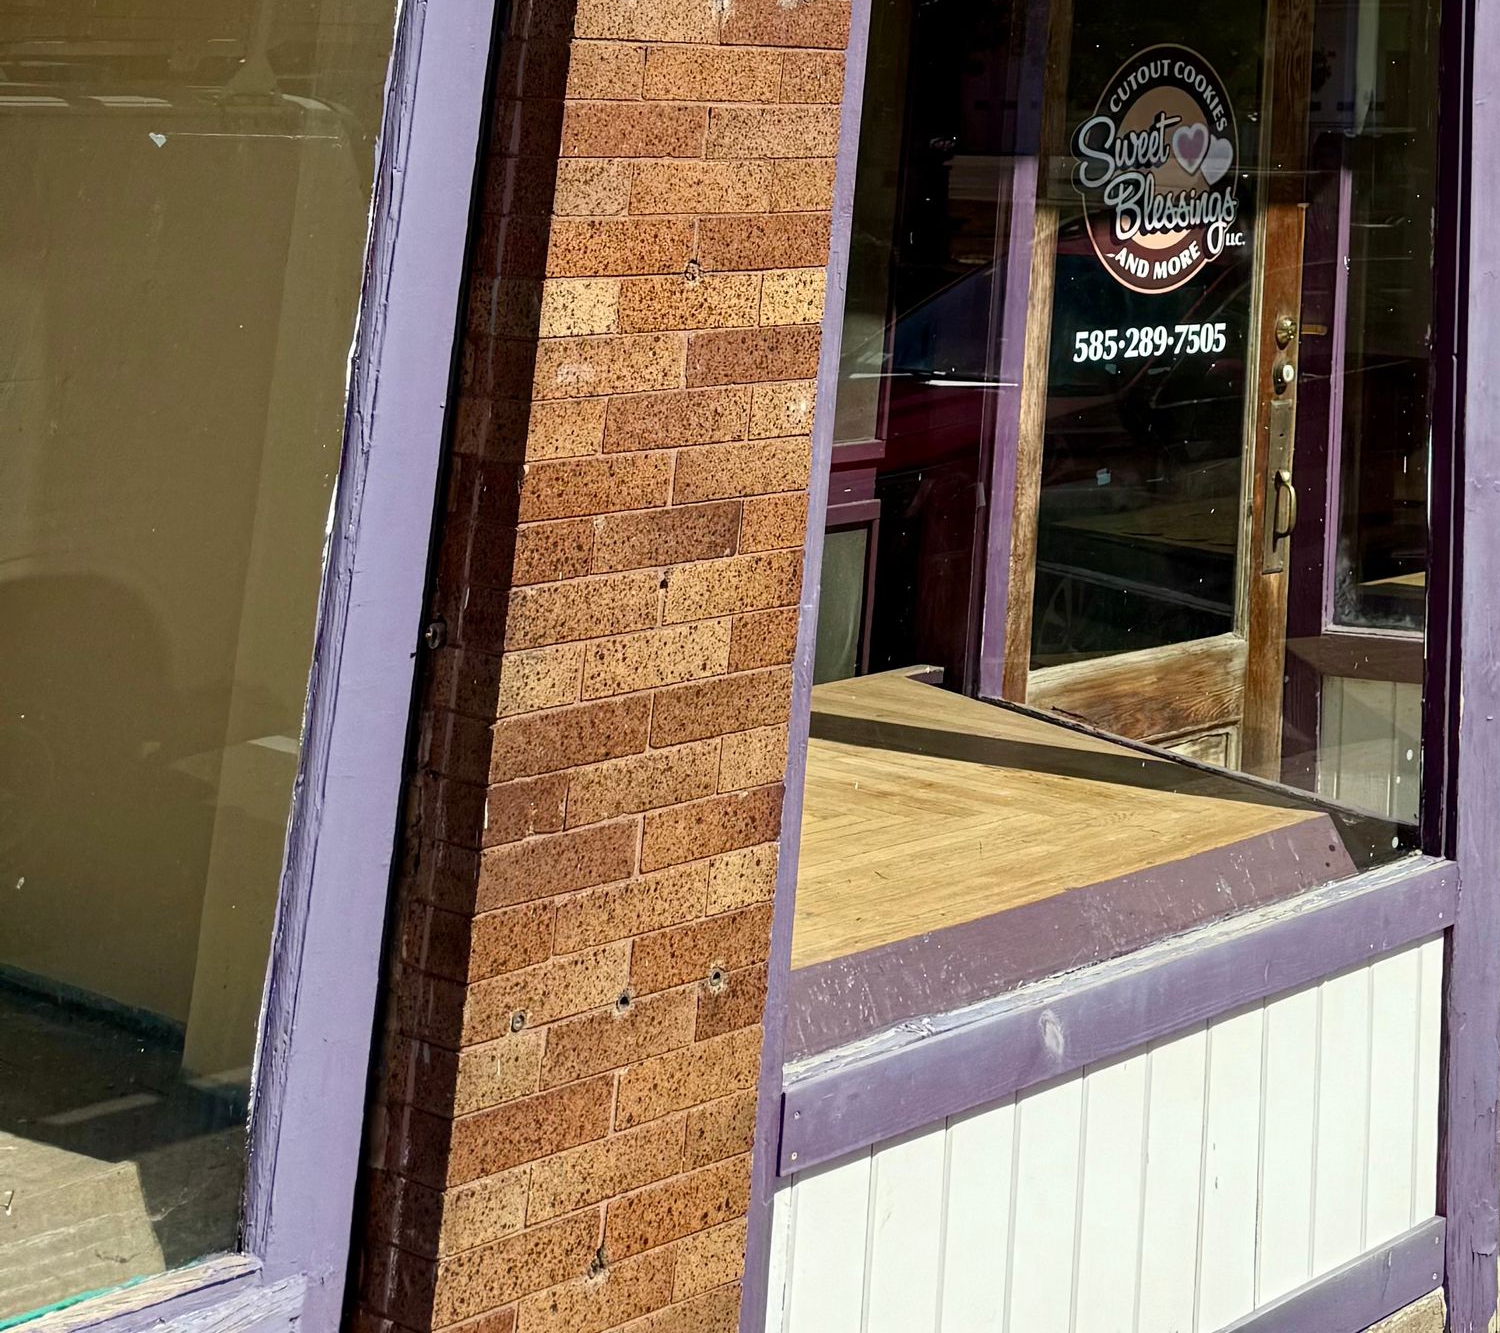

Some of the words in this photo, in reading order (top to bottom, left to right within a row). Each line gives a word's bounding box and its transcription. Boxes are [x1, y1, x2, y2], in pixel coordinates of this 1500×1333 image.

[1110, 59, 1171, 113] CUTOUT
[1174, 61, 1228, 132] COOKIES
[1078, 112, 1182, 188] Sweet
[1103, 172, 1237, 254] Blessings
[1115, 247, 1149, 278] AND
[1153, 240, 1200, 280] MORE
